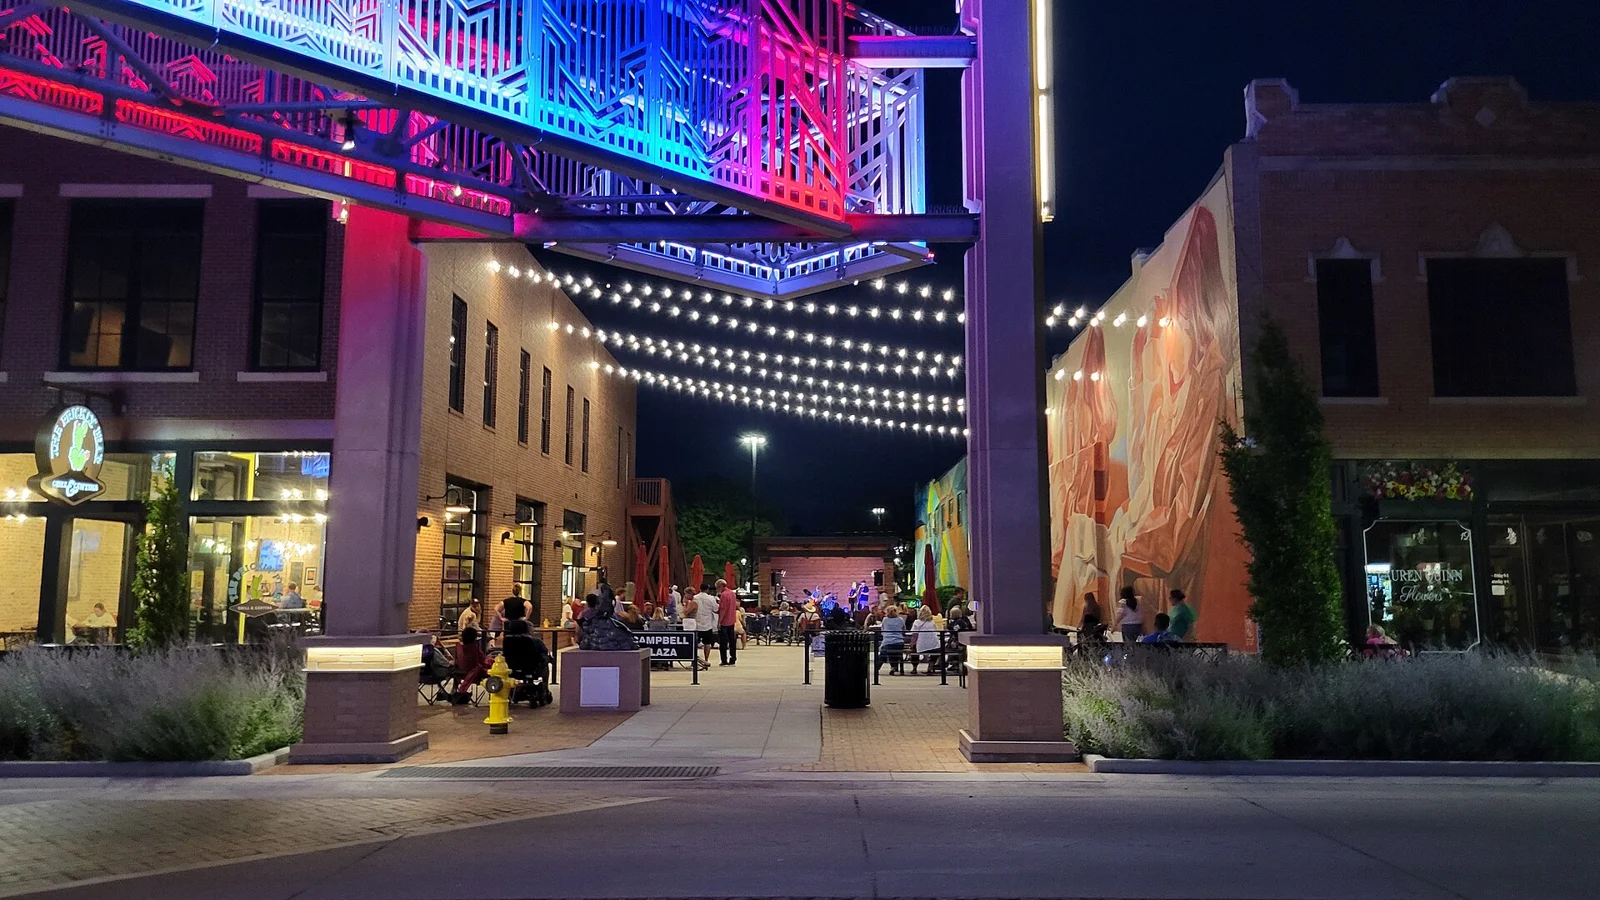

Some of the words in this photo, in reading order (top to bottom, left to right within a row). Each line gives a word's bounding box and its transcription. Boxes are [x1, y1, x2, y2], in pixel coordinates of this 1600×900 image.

[50, 424, 63, 460] THE
[60, 407, 98, 429] PRICKLY
[92, 426, 104, 465] PEAR
[1400, 584, 1443, 602] Flowers
[650, 648, 678, 657] LAZA
